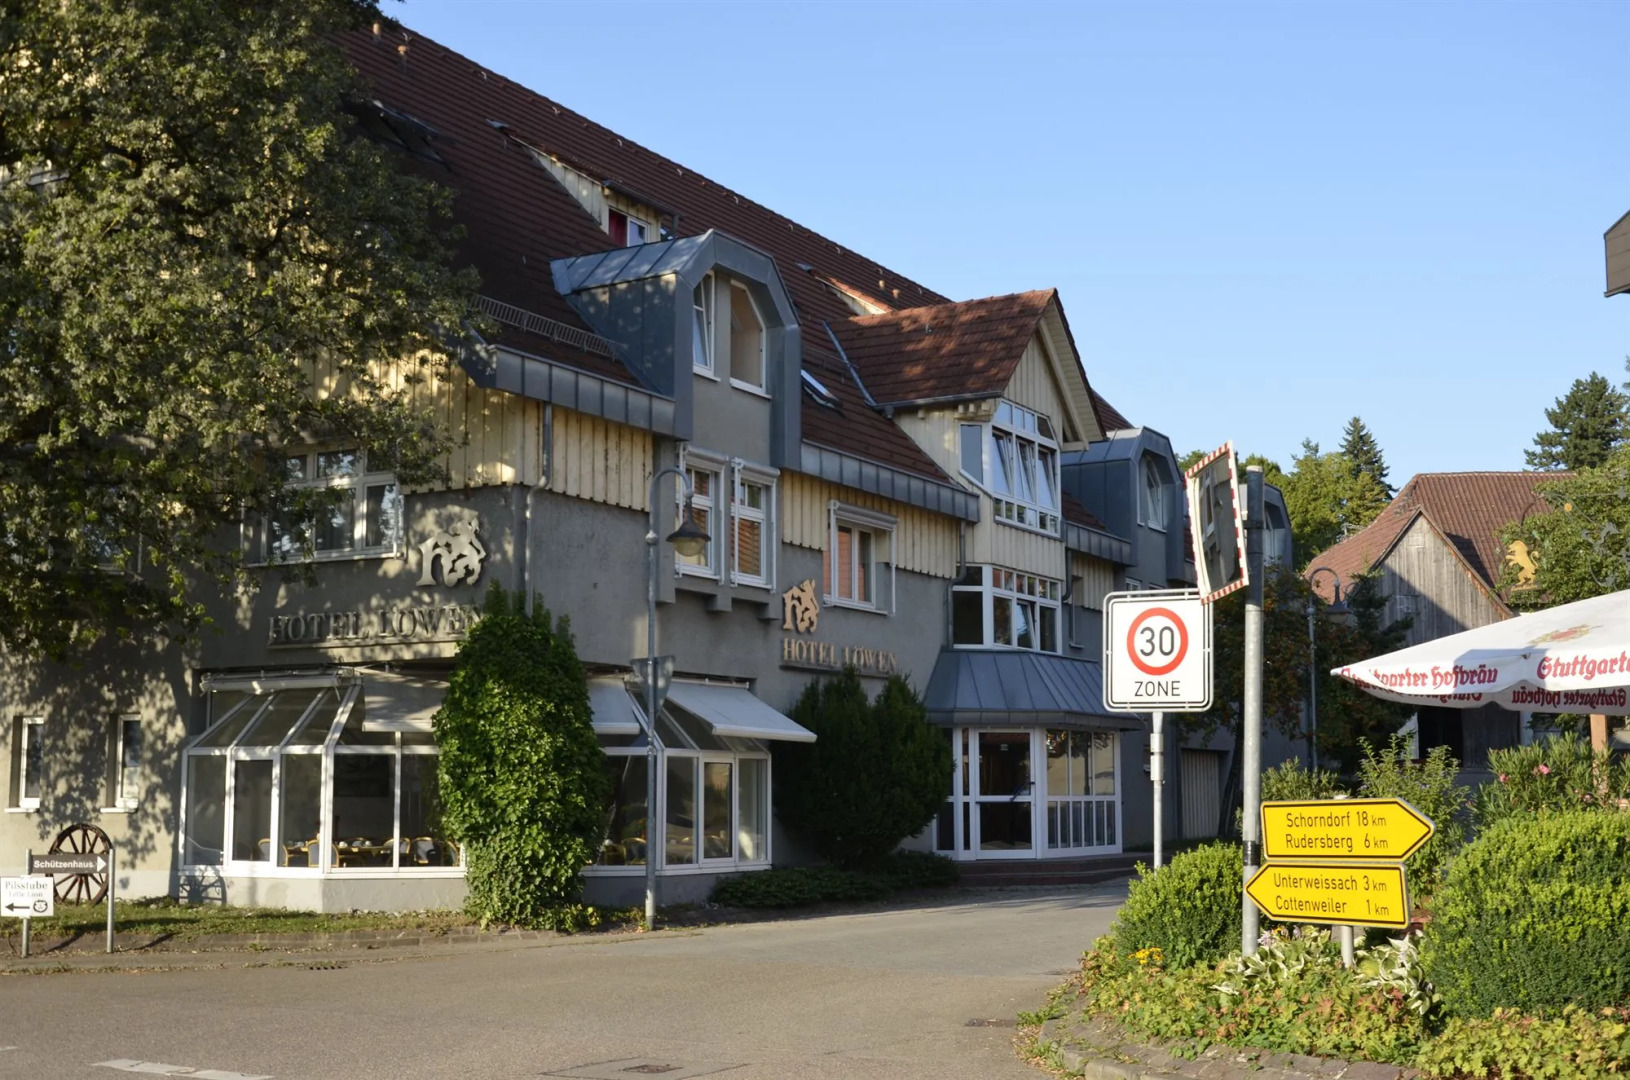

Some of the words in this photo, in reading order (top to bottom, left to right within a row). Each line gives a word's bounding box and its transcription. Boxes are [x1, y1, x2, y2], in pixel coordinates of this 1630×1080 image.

[268, 611, 371, 645] HOTEL
[1140, 626, 1175, 657] 30
[783, 638, 840, 667] HOTEL
[843, 646, 898, 673] LÖWEN
[1536, 650, 1630, 681] Stuttgart
[1431, 664, 1498, 689] Hofbräu
[1134, 680, 1181, 697] ZONE
[1286, 811, 1350, 828] Schorndorf
[1356, 811, 1369, 827] 18
[1371, 815, 1387, 827] km
[1285, 833, 1353, 852] Rudersberg
[1364, 833, 1371, 849] 6
[1373, 838, 1389, 849] km
[33, 859, 94, 869] Schützenhaus
[5, 880, 48, 890] Pilsstube
[1273, 873, 1358, 891] Unterweissach
[1363, 875, 1370, 891] 3
[1372, 880, 1388, 892] km
[1275, 895, 1347, 914] Cottenweiler
[1365, 899, 1371, 915] 1
[1374, 904, 1390, 916] km
